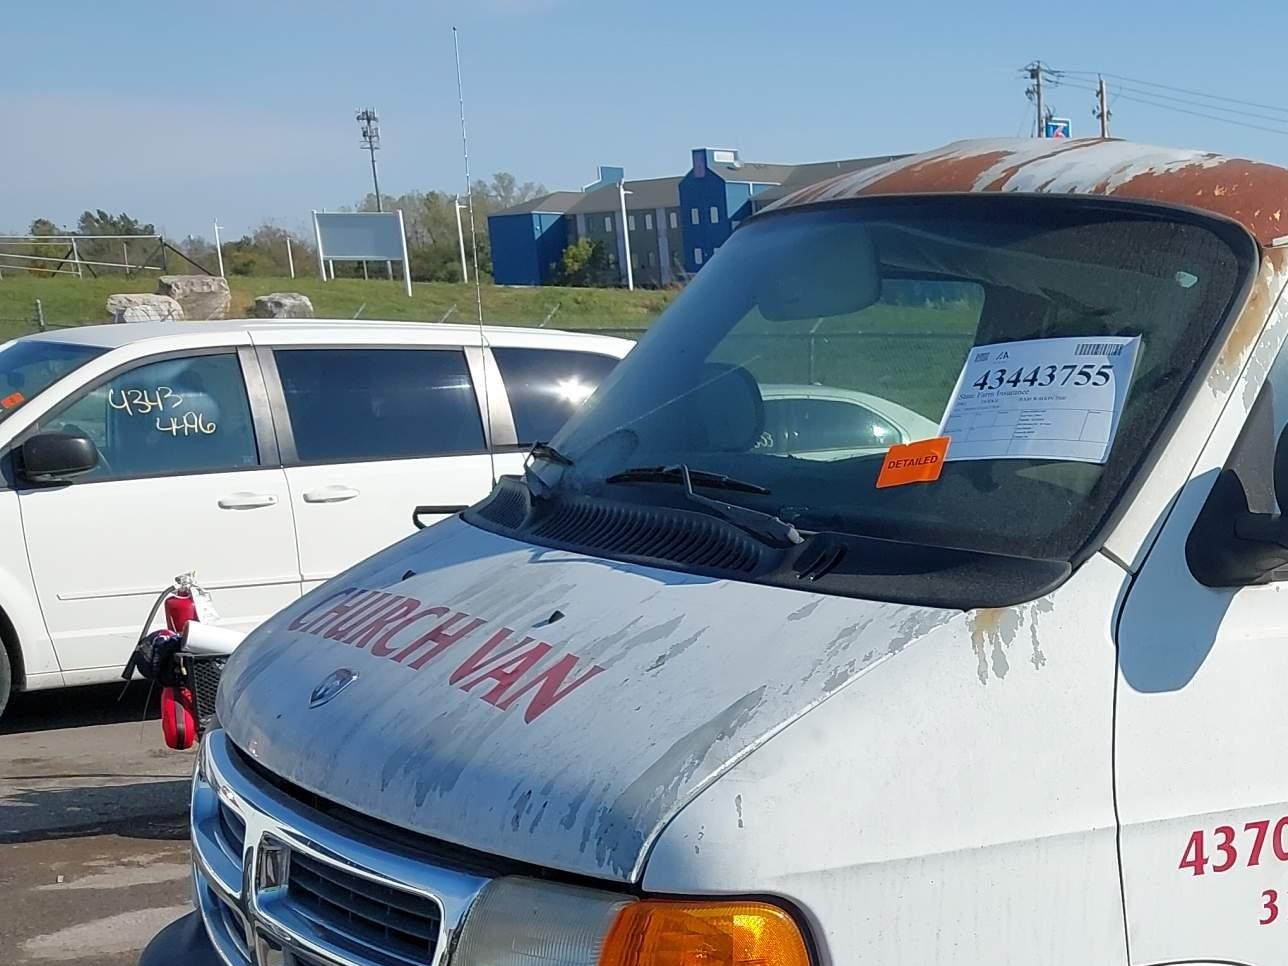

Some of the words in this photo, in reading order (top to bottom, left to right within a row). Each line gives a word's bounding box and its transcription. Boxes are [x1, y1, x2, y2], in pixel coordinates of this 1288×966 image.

[973, 365, 1115, 391] 43443755
[108, 387, 183, 416] 4343
[888, 455, 938, 470] DETAILED
[288, 587, 489, 671] CHURCH
[449, 627, 606, 724] VAN
